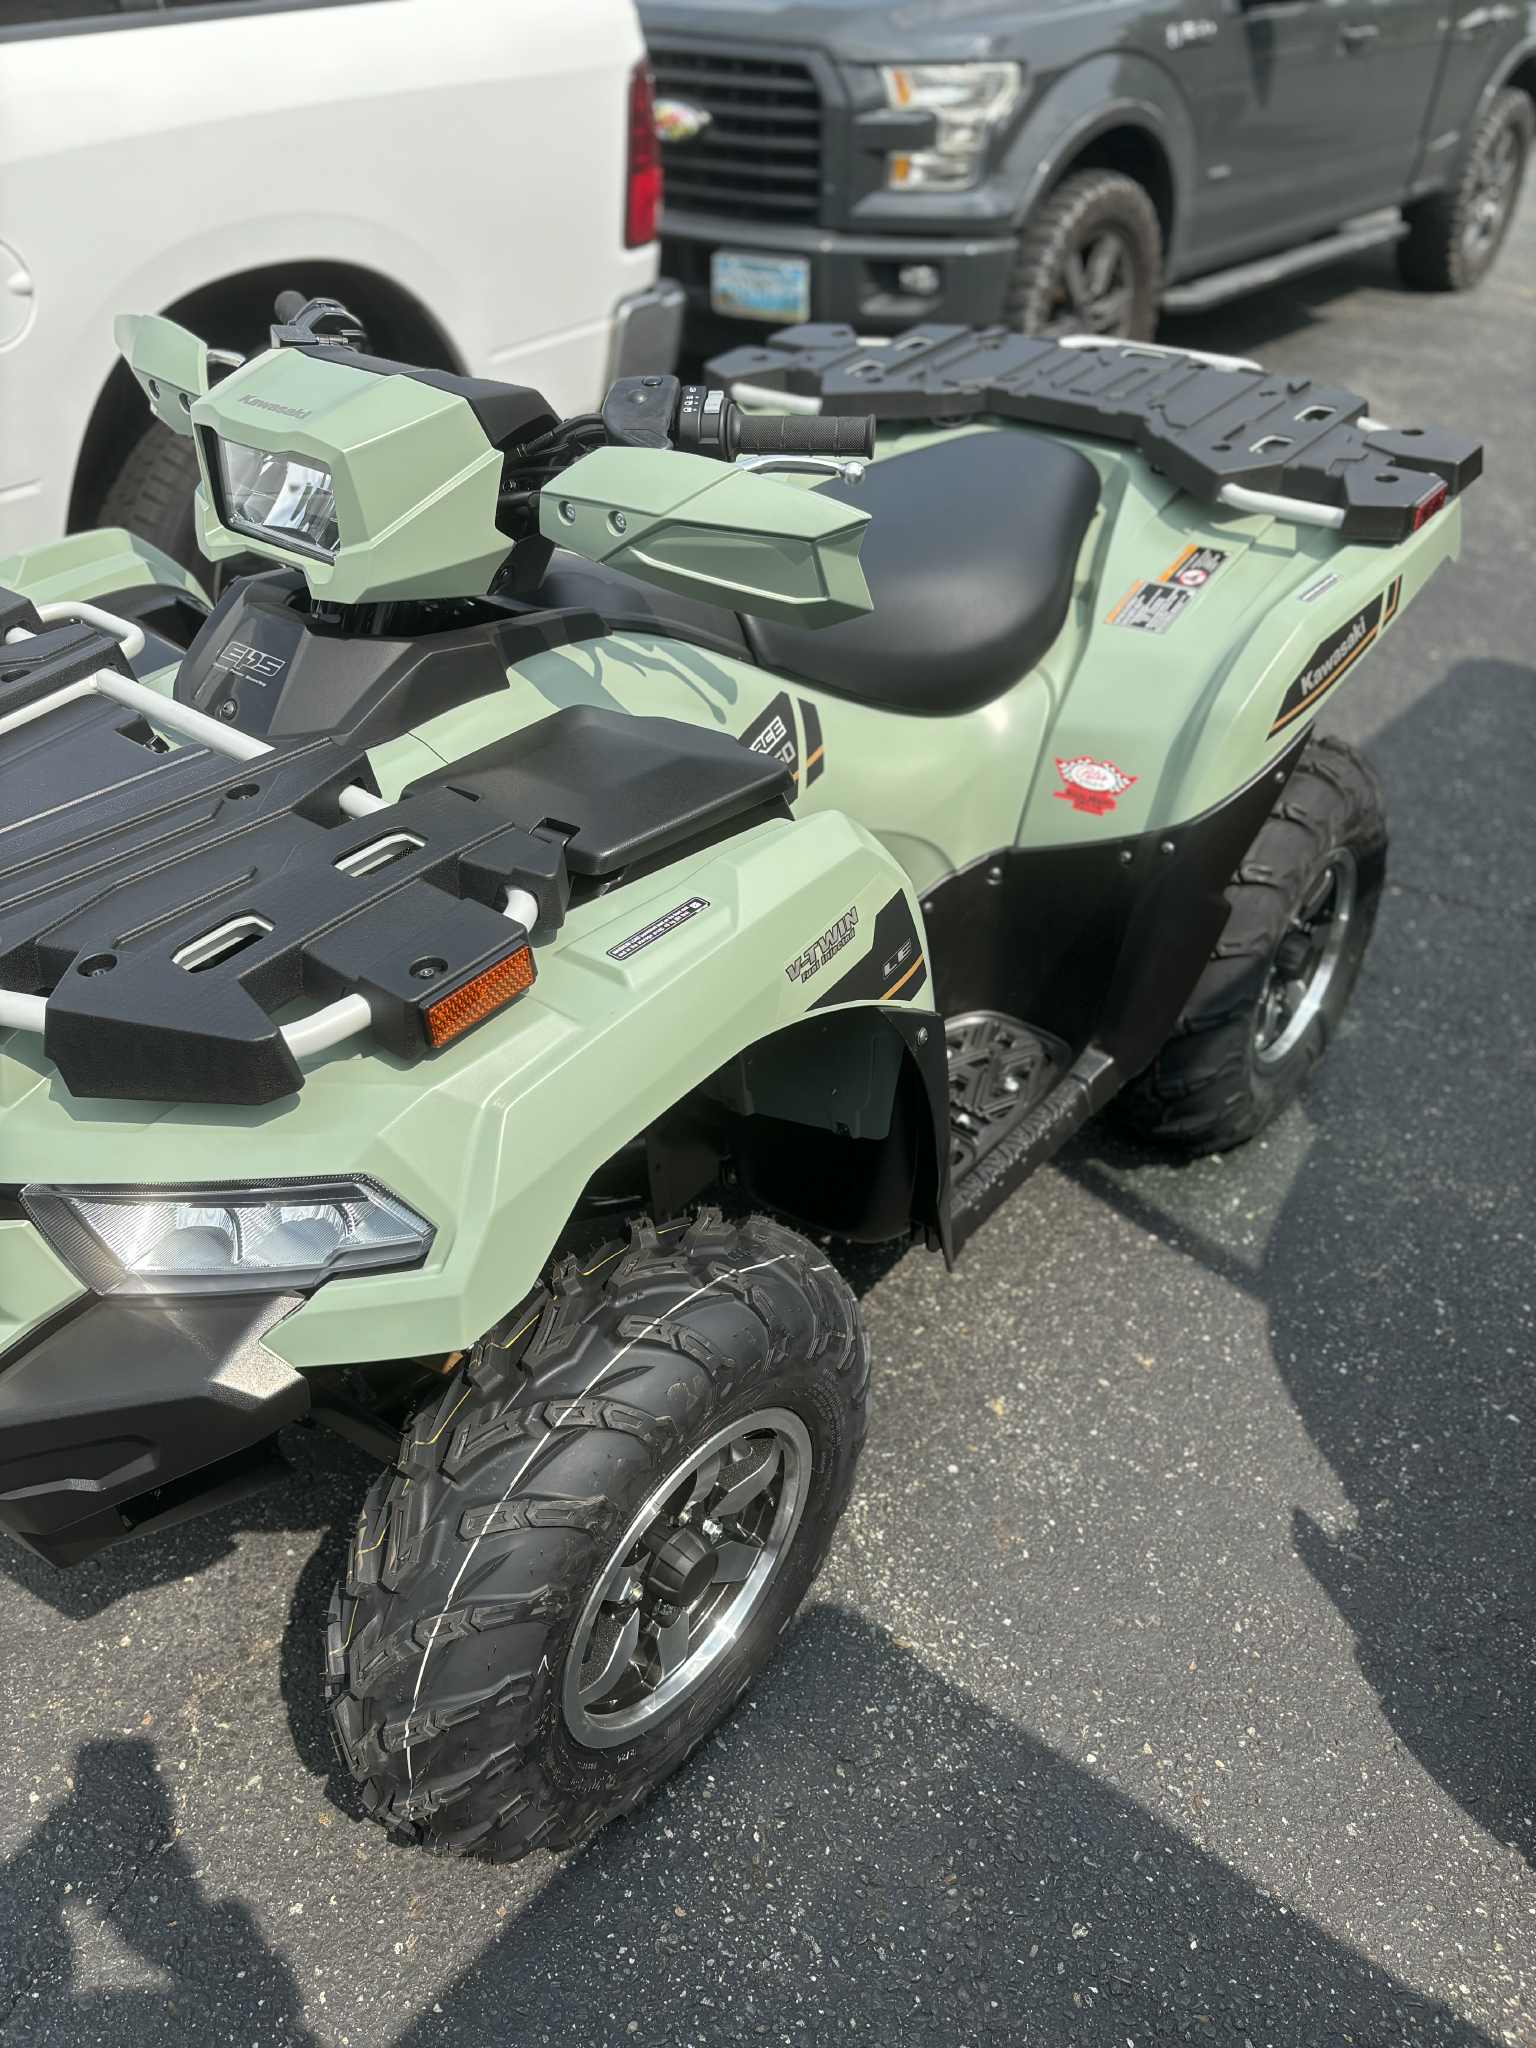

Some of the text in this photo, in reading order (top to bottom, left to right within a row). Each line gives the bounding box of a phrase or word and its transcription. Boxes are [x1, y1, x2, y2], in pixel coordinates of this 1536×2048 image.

[238, 394, 312, 420] Kawasaki
[220, 641, 286, 677] EPS
[1300, 615, 1367, 696] Kawasaki
[785, 906, 859, 982] V-TWIN
[882, 938, 912, 980] LE
